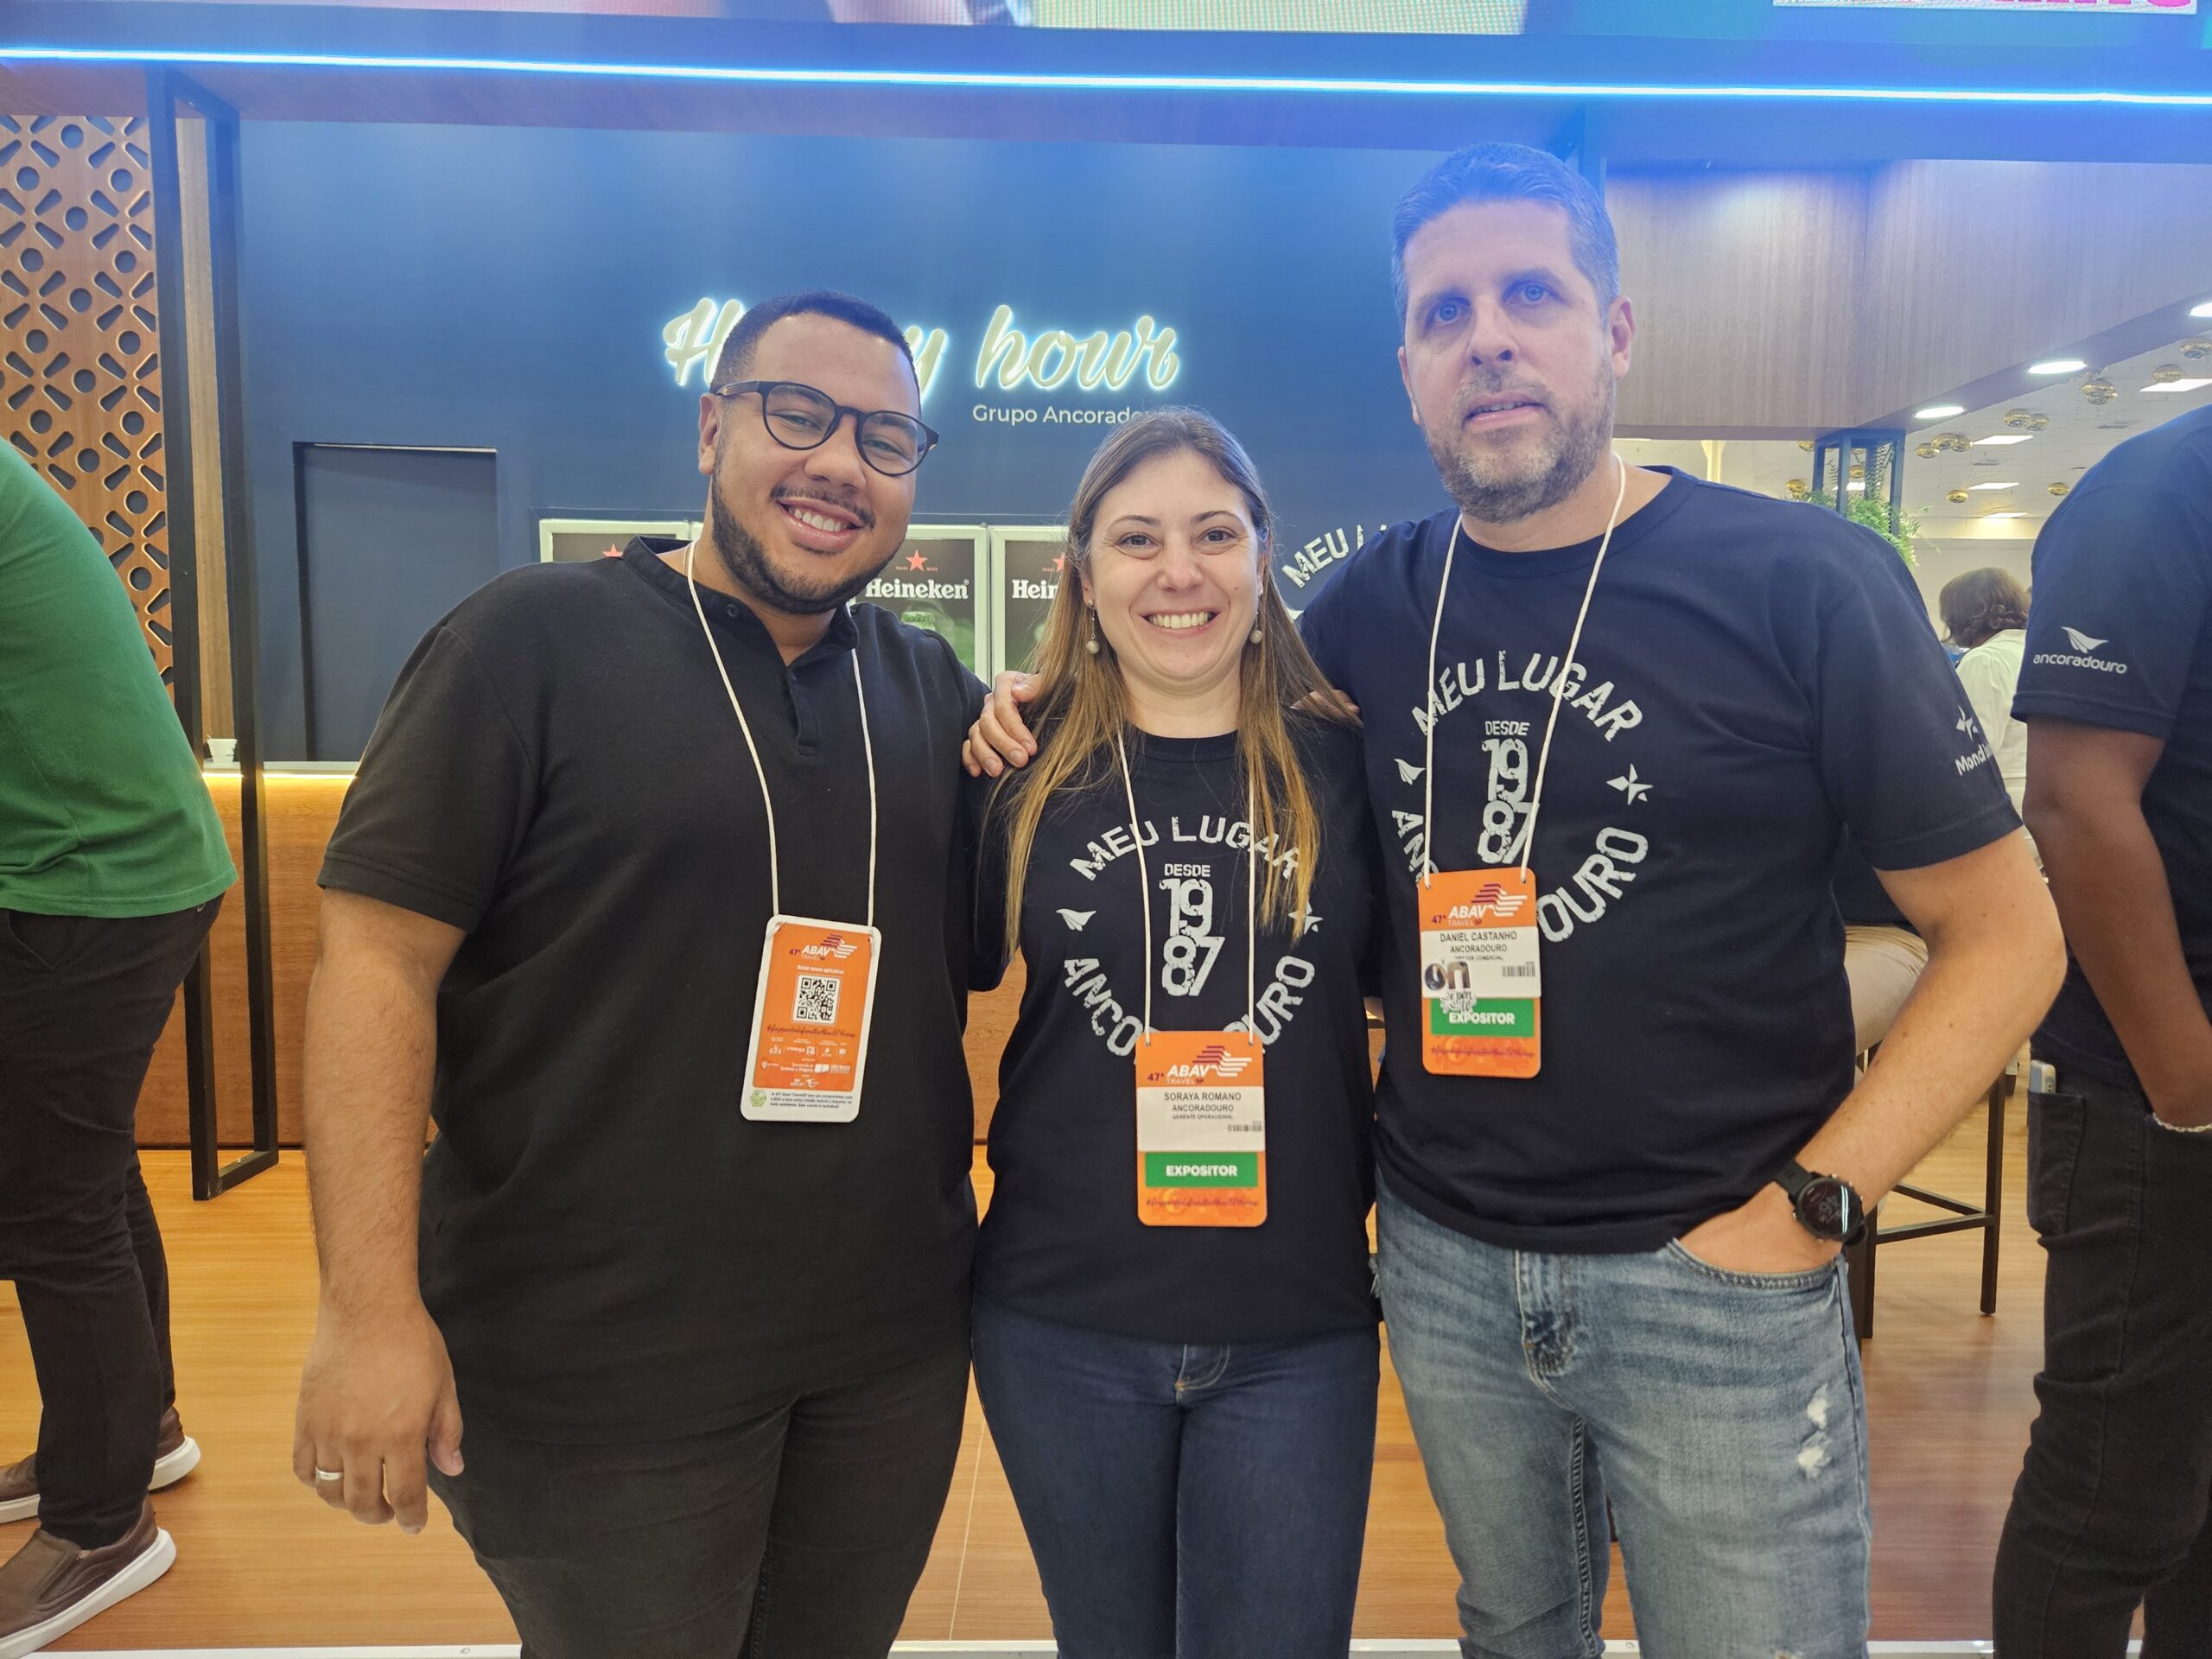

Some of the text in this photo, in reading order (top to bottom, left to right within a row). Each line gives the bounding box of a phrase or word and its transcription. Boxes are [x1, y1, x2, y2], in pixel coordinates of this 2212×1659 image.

[976, 305, 1179, 389] hour
[972, 404, 1141, 425] Grupo Ancorad
[1281, 527, 1349, 588] MEU
[865, 578, 969, 599] Heineken
[2033, 654, 2127, 673] ancoradouro
[1412, 650, 1643, 742] MEU LUGAR
[1484, 721, 1530, 736] DESDE
[1070, 815, 1301, 881] MEU LUGAR
[1164, 864, 1211, 877] DESDE
[1448, 905, 1486, 918] ABAV
[1440, 931, 1517, 942] DANIEL CASTANHO
[802, 944, 830, 957] ABAV
[1450, 944, 1507, 953] ANCORADOURO
[1448, 1012, 1516, 1024] EXPOSITOR
[1166, 1065, 1210, 1077] ABAV
[1164, 1092, 1242, 1101] SORAYA ROMANO
[1166, 1165, 1238, 1177] EXPOSITOR
